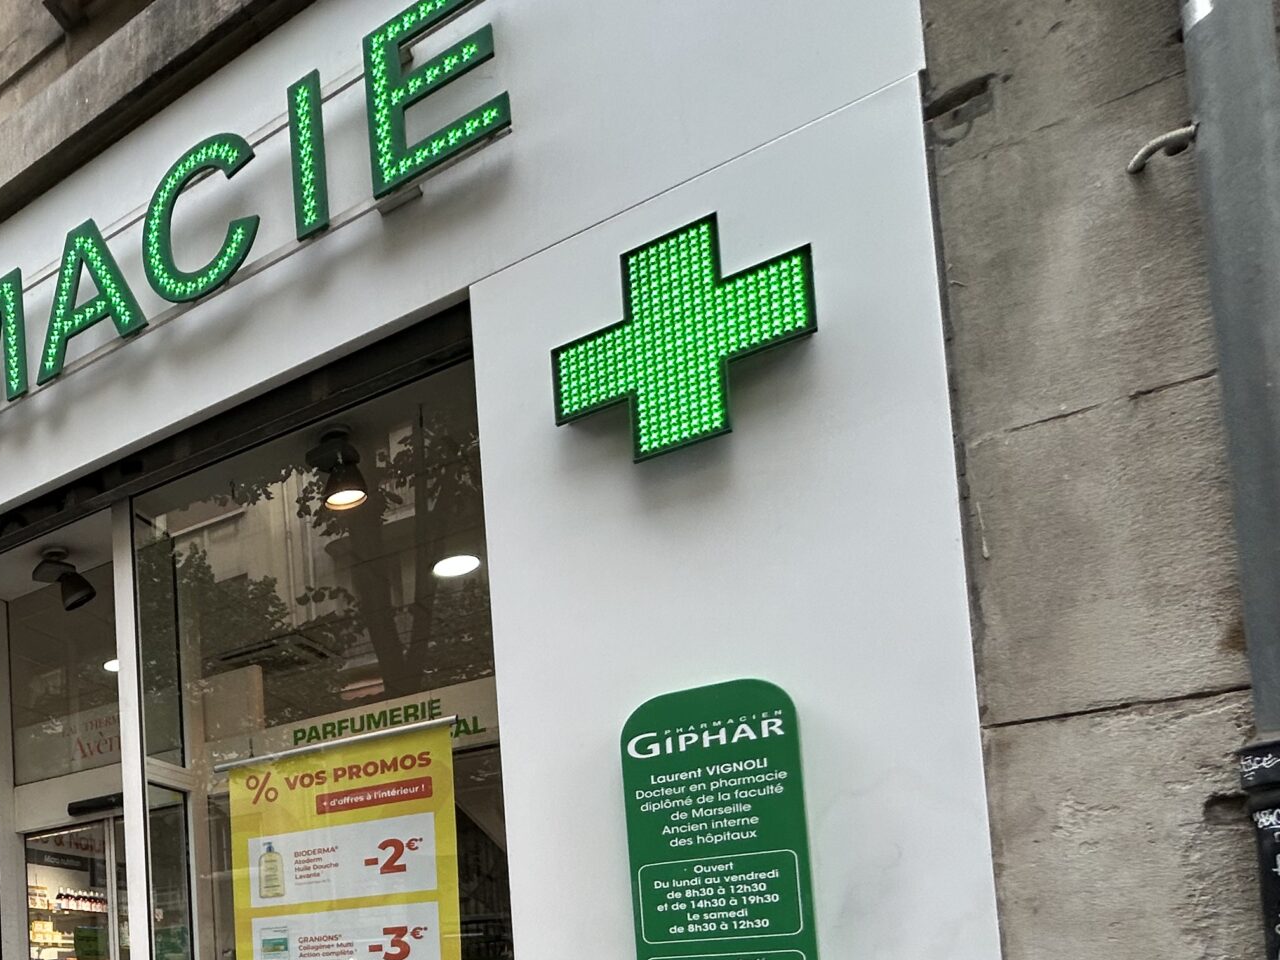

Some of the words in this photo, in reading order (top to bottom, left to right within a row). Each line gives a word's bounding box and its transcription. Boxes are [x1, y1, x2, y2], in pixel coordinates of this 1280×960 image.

[293, 698, 442, 746] PARFUMERIE
[664, 709, 783, 735] PHARMACIEN
[627, 718, 784, 759] GIPHAR
[284, 770, 328, 791] VOS
[332, 750, 433, 783] PROMOS
[650, 768, 702, 785] Laurent
[706, 757, 768, 776] VIGNOLI
[635, 786, 686, 800] Docteur
[689, 783, 706, 792] en
[710, 770, 788, 791] pharmacie
[329, 794, 365, 807] d'offres
[366, 790, 372, 801] à
[373, 785, 419, 799] l'intérieur
[640, 796, 693, 812] diplômé
[696, 794, 714, 804] de
[718, 791, 731, 801] la
[734, 783, 784, 799] faculté
[670, 811, 688, 821] de
[691, 802, 752, 818] Marseille
[662, 821, 708, 835] Ancien
[711, 815, 759, 829] interne
[669, 836, 693, 847] des
[696, 829, 757, 845] hôpitaux
[312, 862, 339, 871] Douche
[693, 862, 734, 874] Ouvert
[654, 880, 669, 889] Du
[672, 877, 701, 888] lundi
[704, 876, 720, 884] au
[723, 869, 779, 883] vendredi
[666, 891, 682, 899] de
[685, 887, 714, 898] 8h30
[717, 886, 725, 895] à
[730, 882, 767, 893] 12h30
[656, 903, 668, 912] et
[671, 902, 687, 911] de
[690, 898, 726, 909] 14h30
[729, 897, 737, 905] à
[742, 893, 780, 904] 19h30
[687, 912, 700, 921] Le
[703, 908, 748, 920] samedi
[669, 925, 684, 934] de
[687, 922, 716, 932] 8h30
[720, 921, 728, 930] à
[732, 919, 770, 930] 12h30
